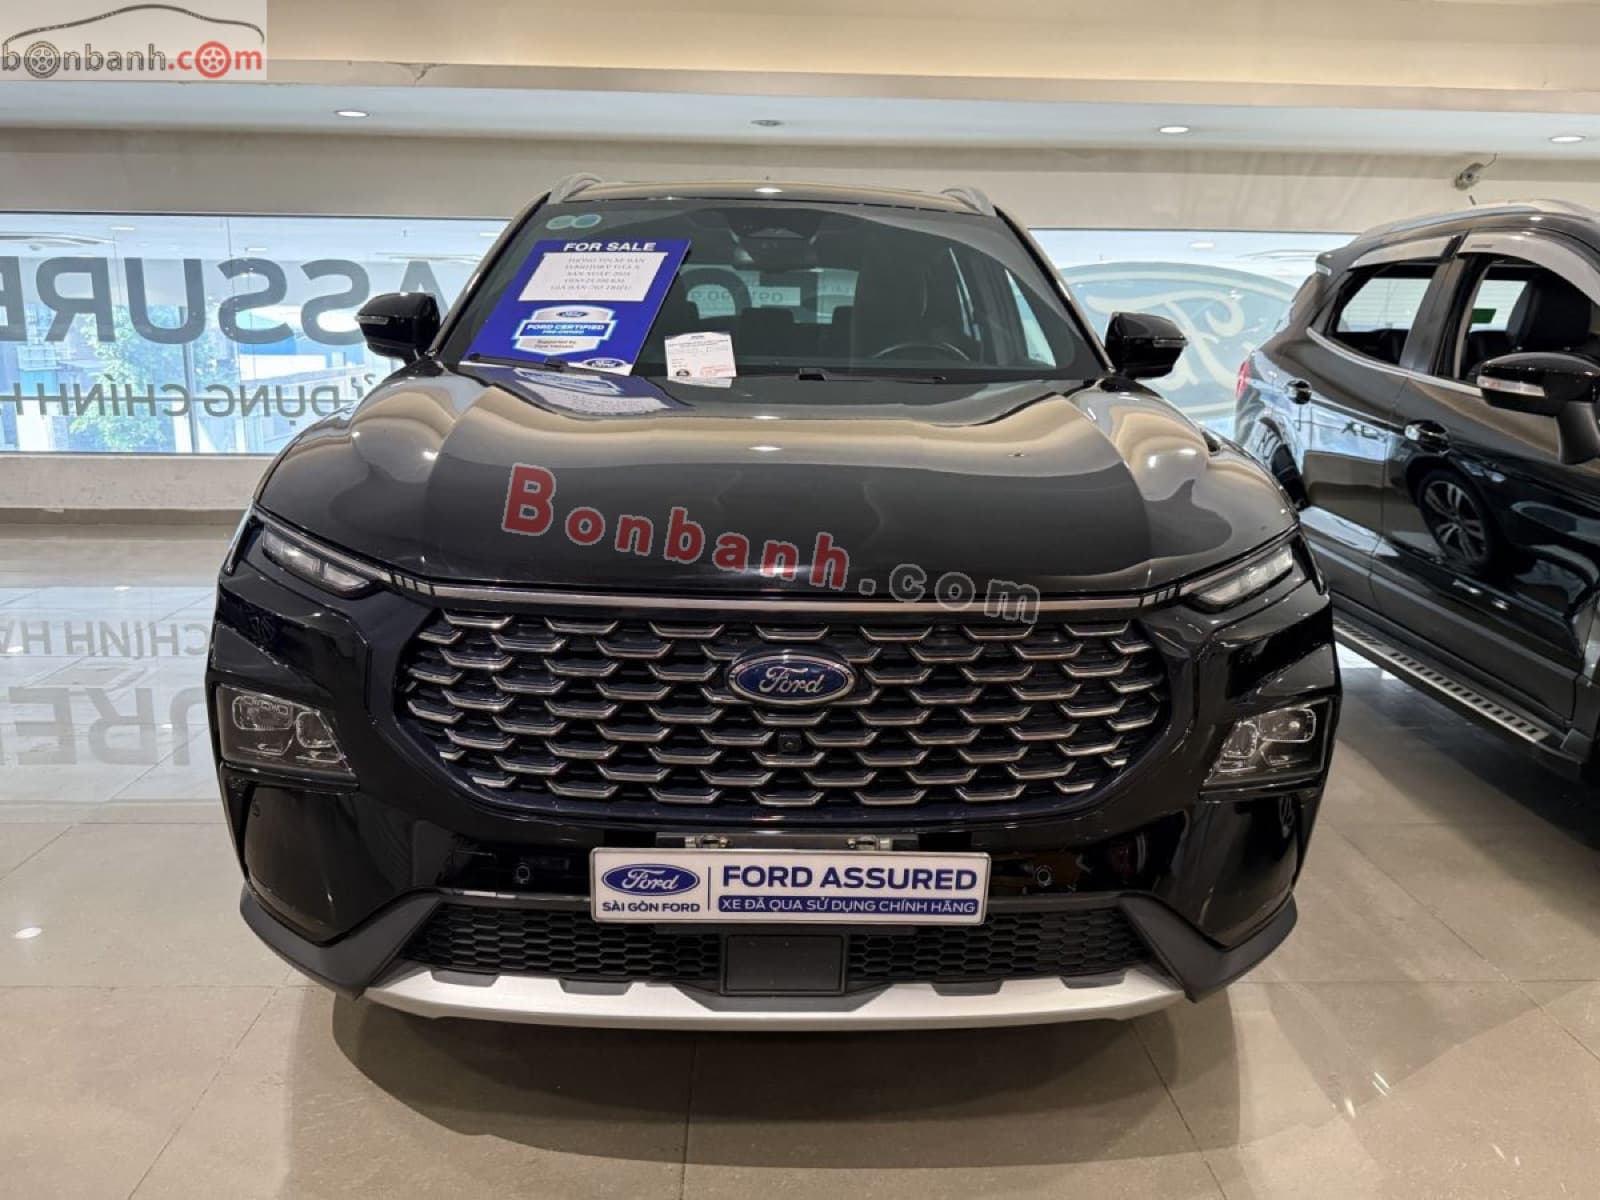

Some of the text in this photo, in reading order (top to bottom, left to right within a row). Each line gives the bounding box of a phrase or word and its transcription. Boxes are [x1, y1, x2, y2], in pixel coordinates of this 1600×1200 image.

[563, 241, 656, 252] FOR SALE
[759, 666, 825, 693] Ford
[622, 868, 680, 890] Ford
[722, 865, 977, 891] FORD ASSURED
[602, 900, 700, 913] SÀI GÒN FORD
[722, 896, 976, 913] XE ĐÃ QUA SỬ DỤNG CHÍNH HÃNG
